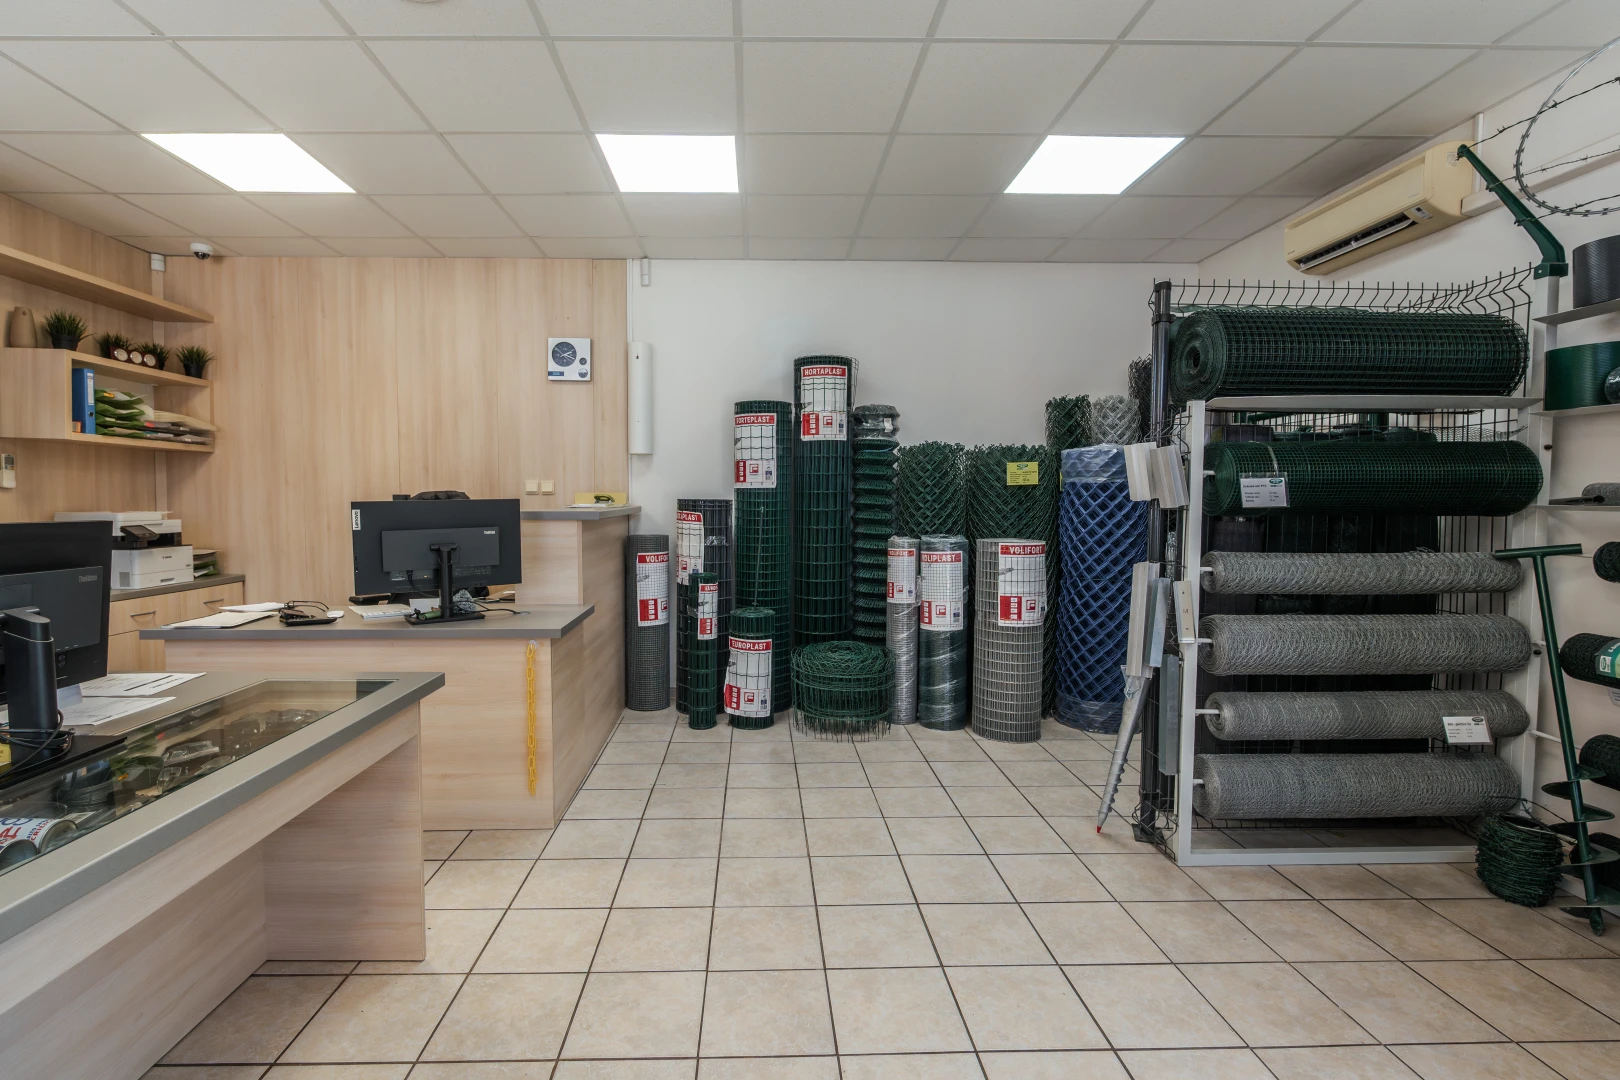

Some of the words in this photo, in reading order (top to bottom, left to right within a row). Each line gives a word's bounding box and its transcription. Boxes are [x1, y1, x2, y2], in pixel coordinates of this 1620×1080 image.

[804, 368, 843, 376] HORTAPLAST
[736, 416, 770, 424] FORTEPLAST
[1009, 546, 1043, 555] VOLIFORT
[731, 640, 767, 650] EUROPLAST
